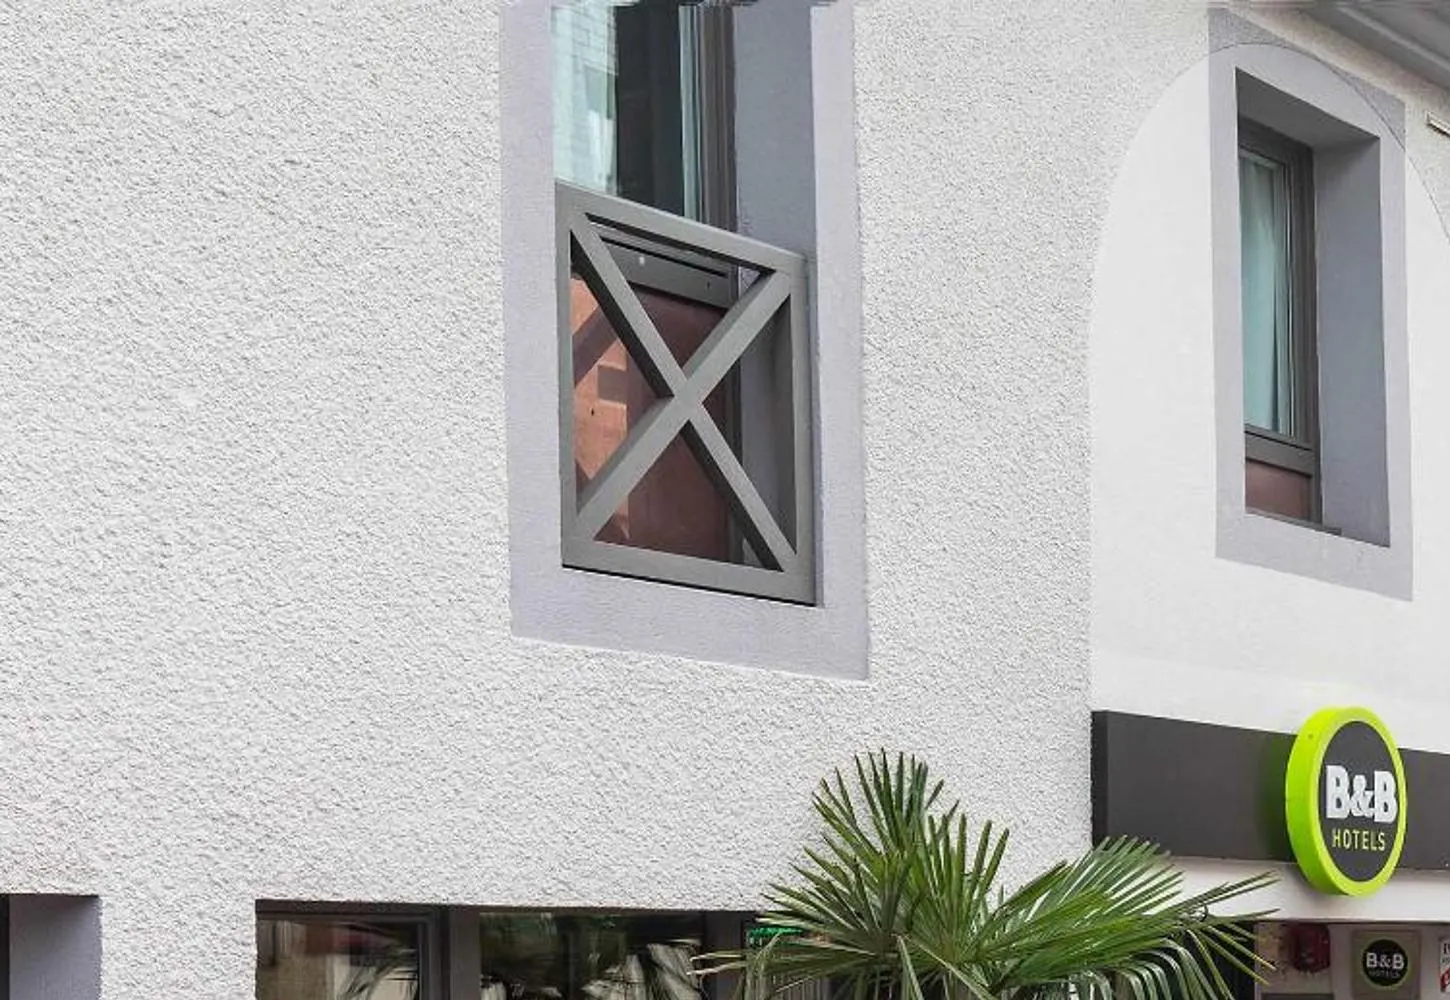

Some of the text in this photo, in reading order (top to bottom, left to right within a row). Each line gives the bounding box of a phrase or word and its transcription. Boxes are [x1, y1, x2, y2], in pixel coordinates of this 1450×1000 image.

[1326, 765, 1397, 823] B&B
[1332, 829, 1386, 851] HOTELS
[1366, 952, 1404, 970] B&B
